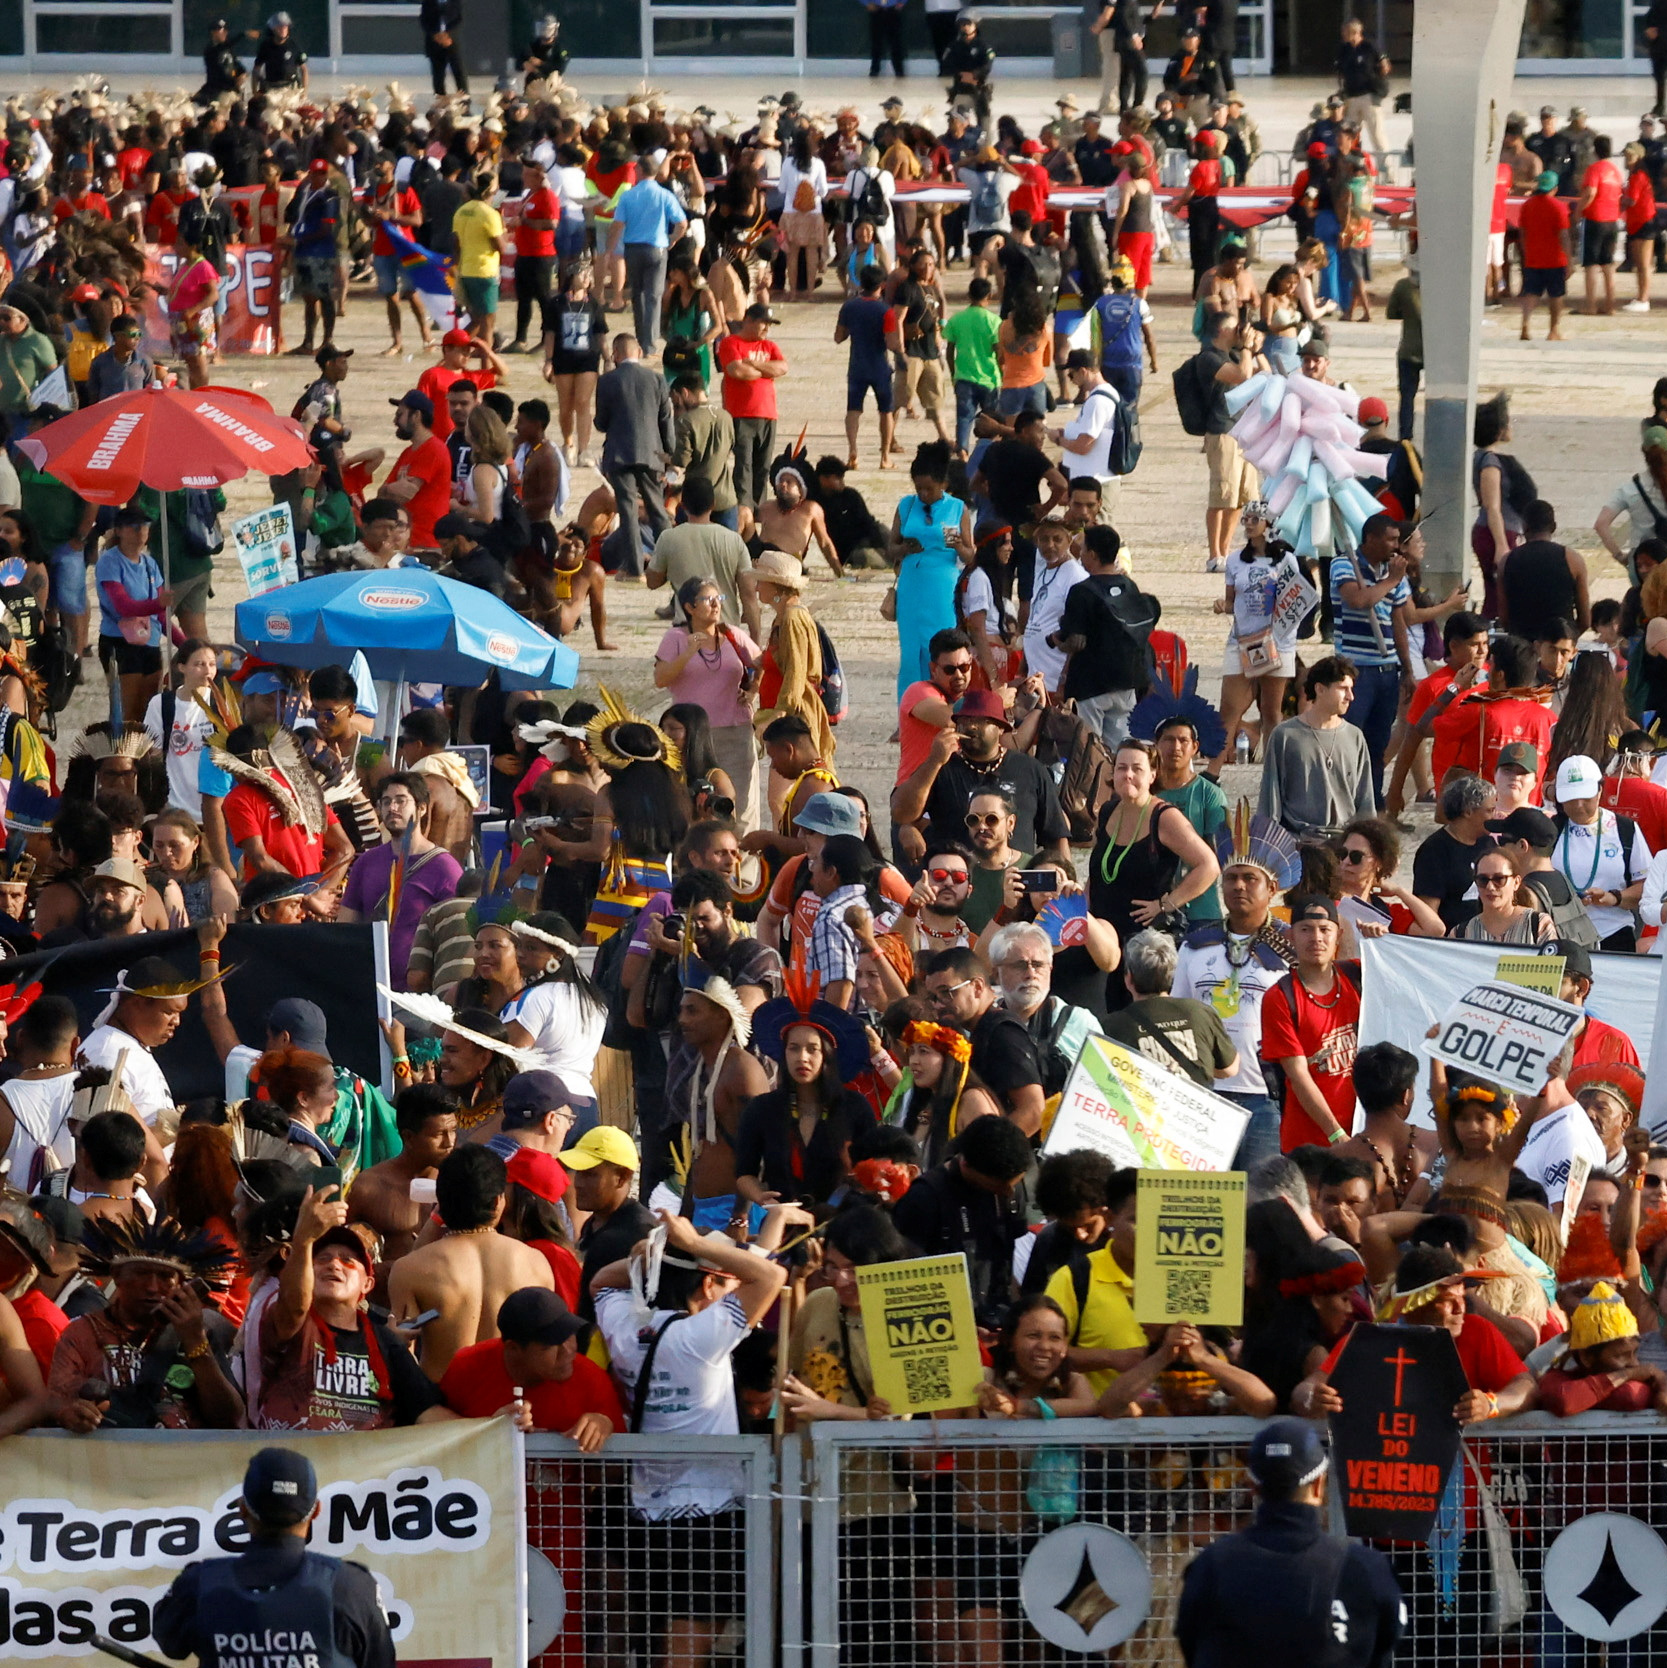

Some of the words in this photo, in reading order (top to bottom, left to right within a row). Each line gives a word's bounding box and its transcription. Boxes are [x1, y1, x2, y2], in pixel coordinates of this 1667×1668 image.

[87, 411, 145, 471] BRAHMA
[195, 401, 275, 453] BRAHMA
[181, 475, 219, 486] BRAHMA
[1464, 986, 1508, 1014] MARCO
[1507, 998, 1573, 1035] TEMPORAL
[1439, 1021, 1546, 1084] GOLPE
[1073, 1091, 1130, 1130] TERRA
[1132, 1121, 1218, 1173] PROTEGIDA
[1158, 1225, 1224, 1256] NÃO
[887, 1316, 954, 1348] NÃO
[315, 1371, 369, 1397] LIVRE
[308, 1405, 344, 1420] CEARÁ
[1378, 1411, 1417, 1437] LEI
[1382, 1439, 1410, 1458] DO
[1346, 1459, 1441, 1494] VENENO
[16, 1511, 201, 1563] Terra
[327, 1475, 480, 1544] Mãe
[213, 1627, 318, 1655] POLÍCIA
